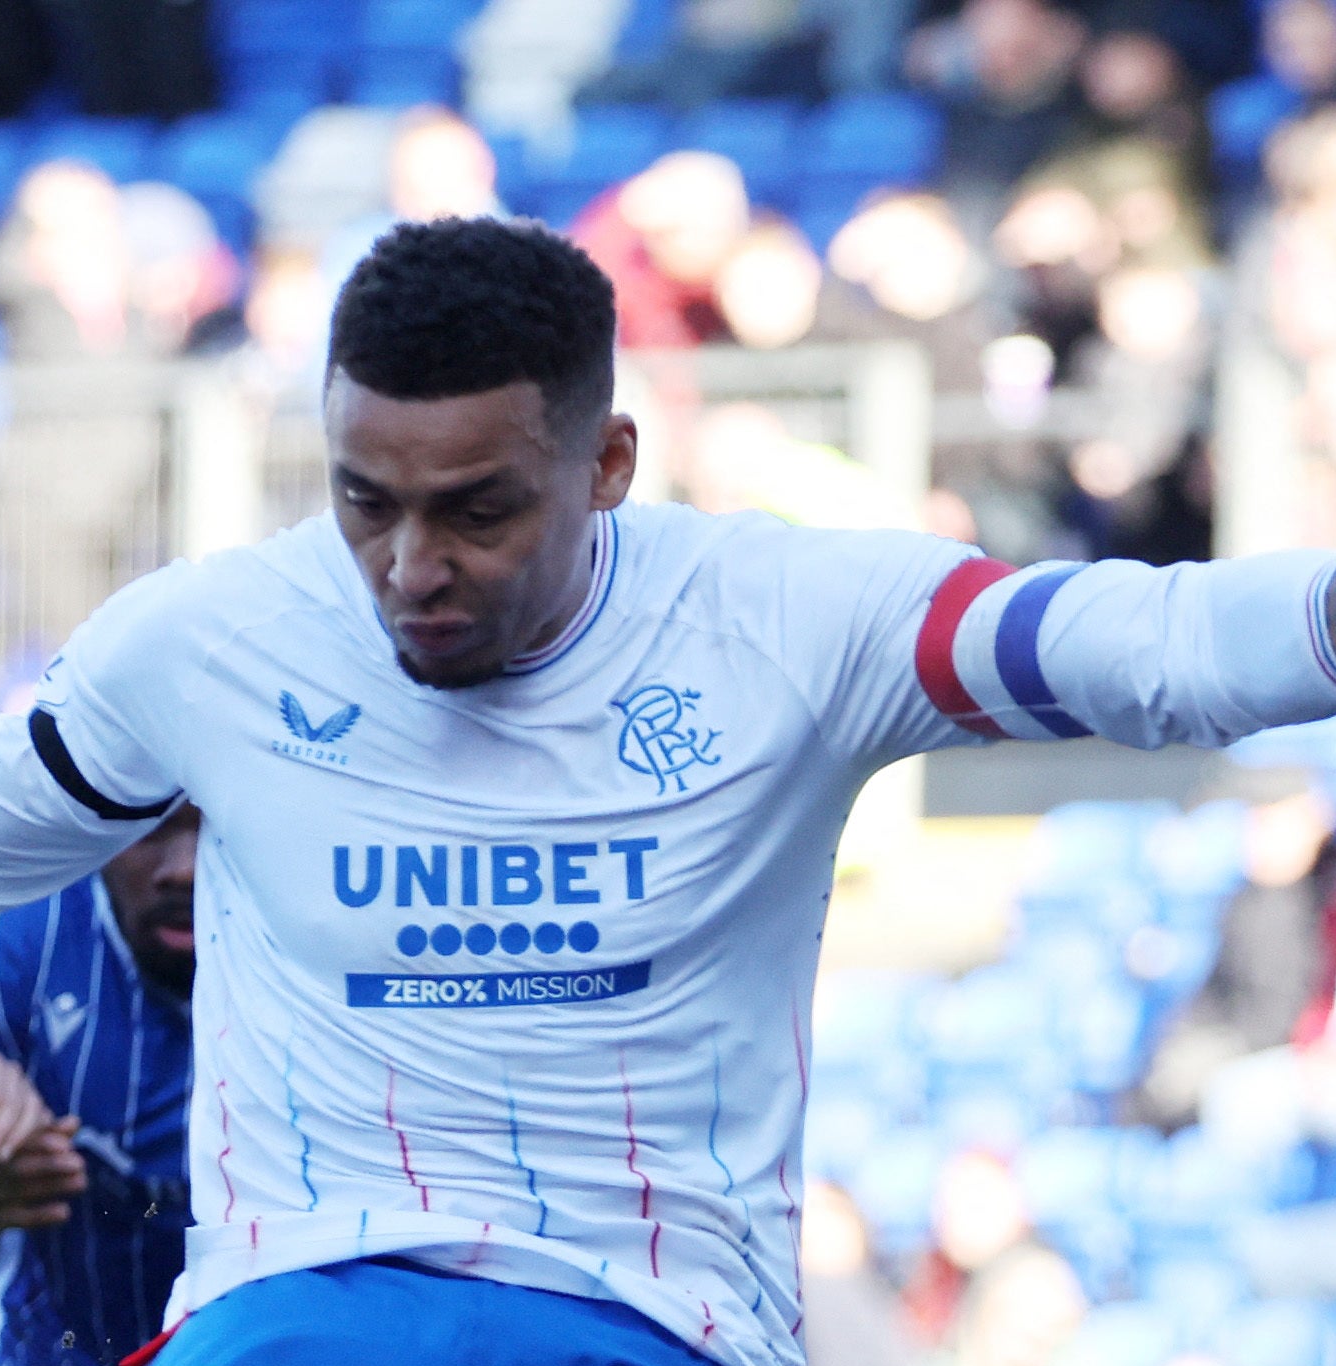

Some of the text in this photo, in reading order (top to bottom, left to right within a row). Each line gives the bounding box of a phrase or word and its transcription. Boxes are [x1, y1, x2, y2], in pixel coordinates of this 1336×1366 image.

[333, 836, 659, 908] UNIBET
[383, 972, 615, 1004] ZERO% MISSION
